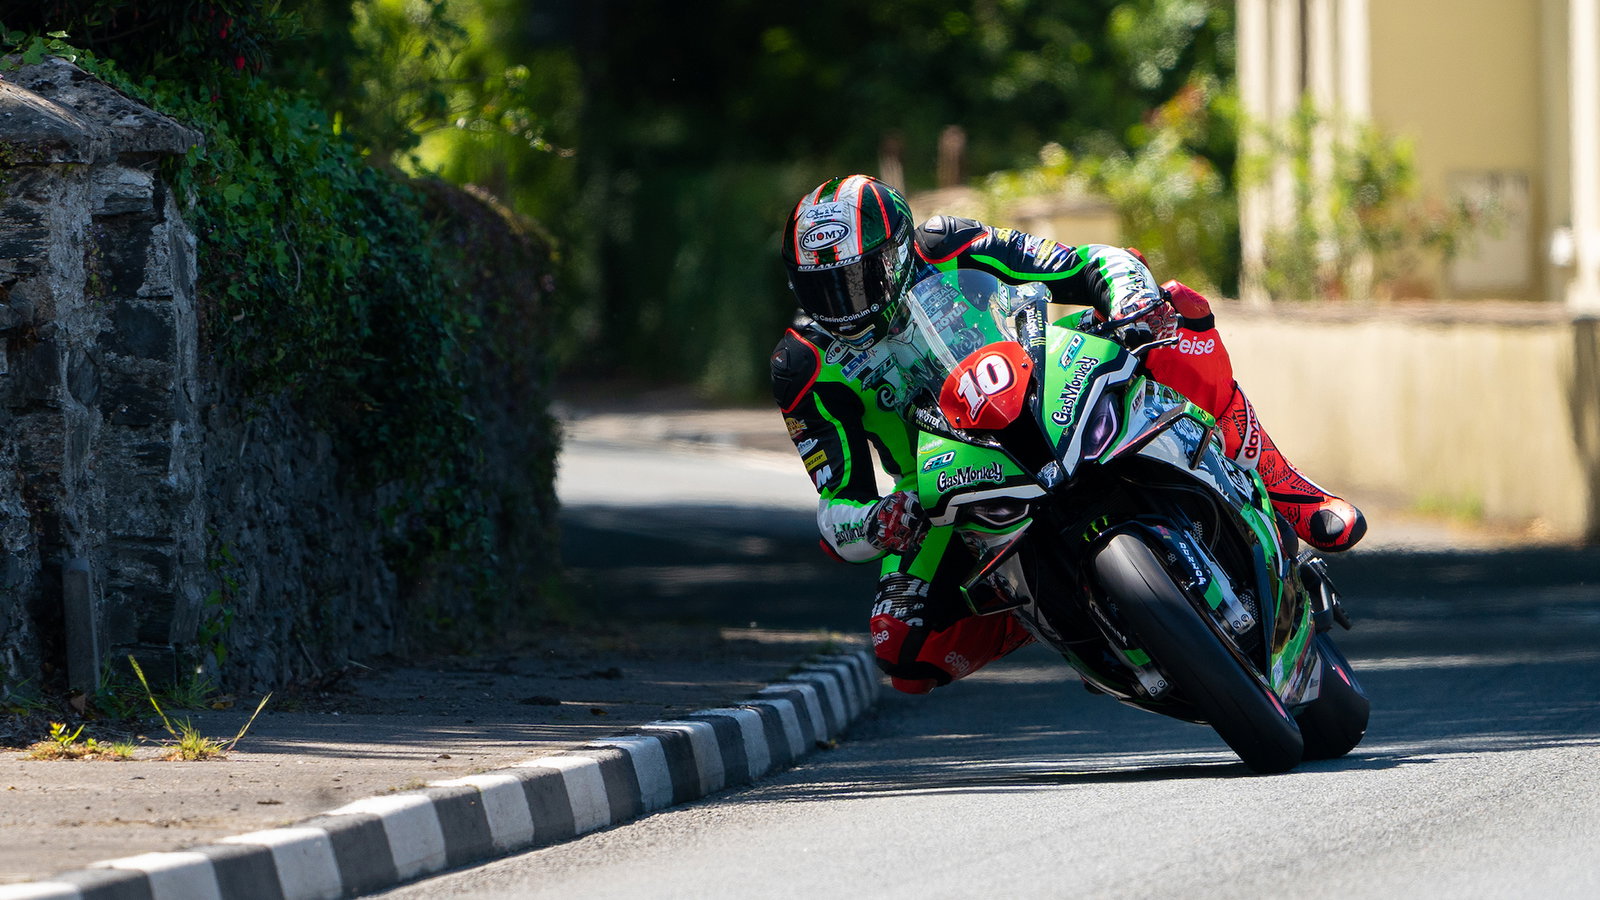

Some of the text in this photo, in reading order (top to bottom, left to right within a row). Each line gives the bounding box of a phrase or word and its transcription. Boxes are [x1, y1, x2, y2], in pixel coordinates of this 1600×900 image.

[805, 229, 844, 244] SUOMY
[820, 308, 871, 323] CasinoCoin.im
[825, 343, 847, 361] SUOM
[957, 355, 1012, 419] 10
[1051, 355, 1100, 426] GasMonkey
[1245, 401, 1260, 459] dayto
[937, 462, 1004, 493] GasMonkey
